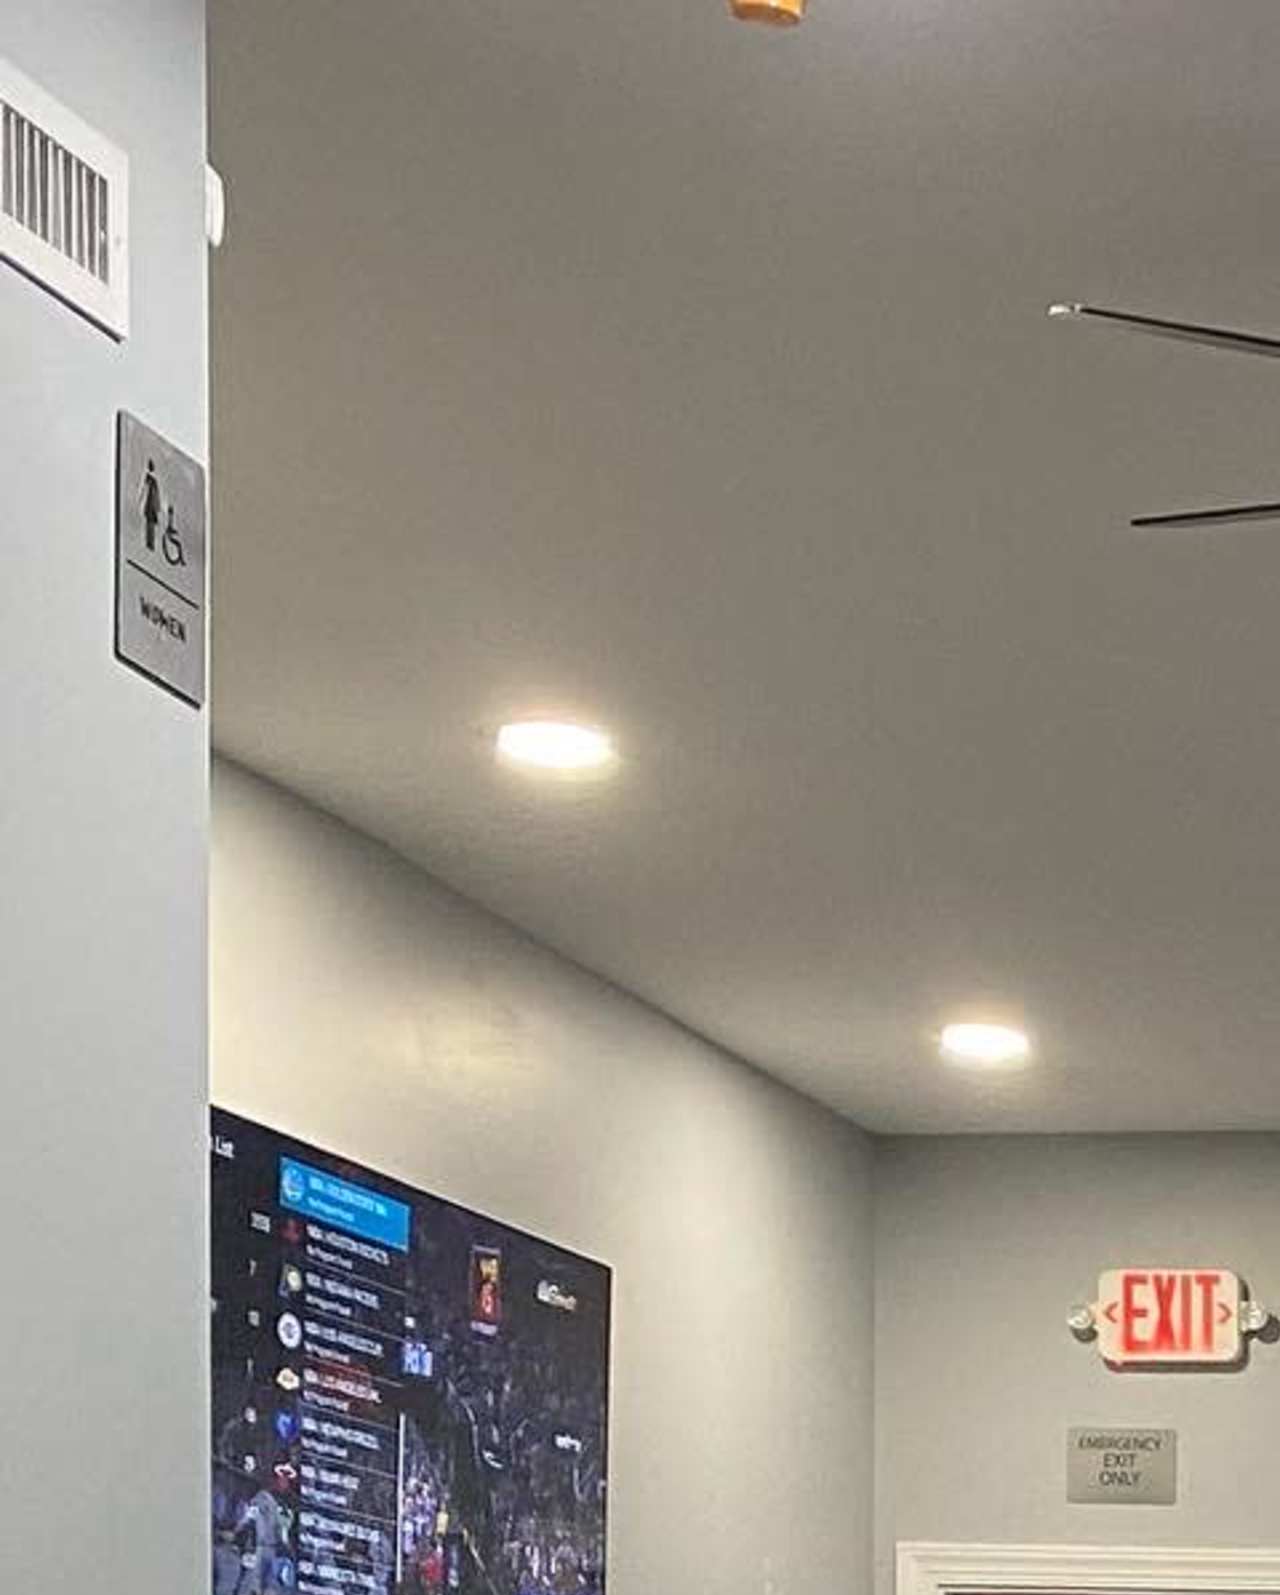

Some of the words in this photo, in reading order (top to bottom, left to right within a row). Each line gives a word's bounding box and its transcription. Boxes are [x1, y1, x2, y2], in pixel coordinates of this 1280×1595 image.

[139, 597, 186, 642] WOMEN
[1122, 1274, 1220, 1353] EXIT
[1077, 1436, 1162, 1451] EMERGENCY
[1103, 1453, 1137, 1468] EXIT
[1098, 1471, 1142, 1486] ONLY
